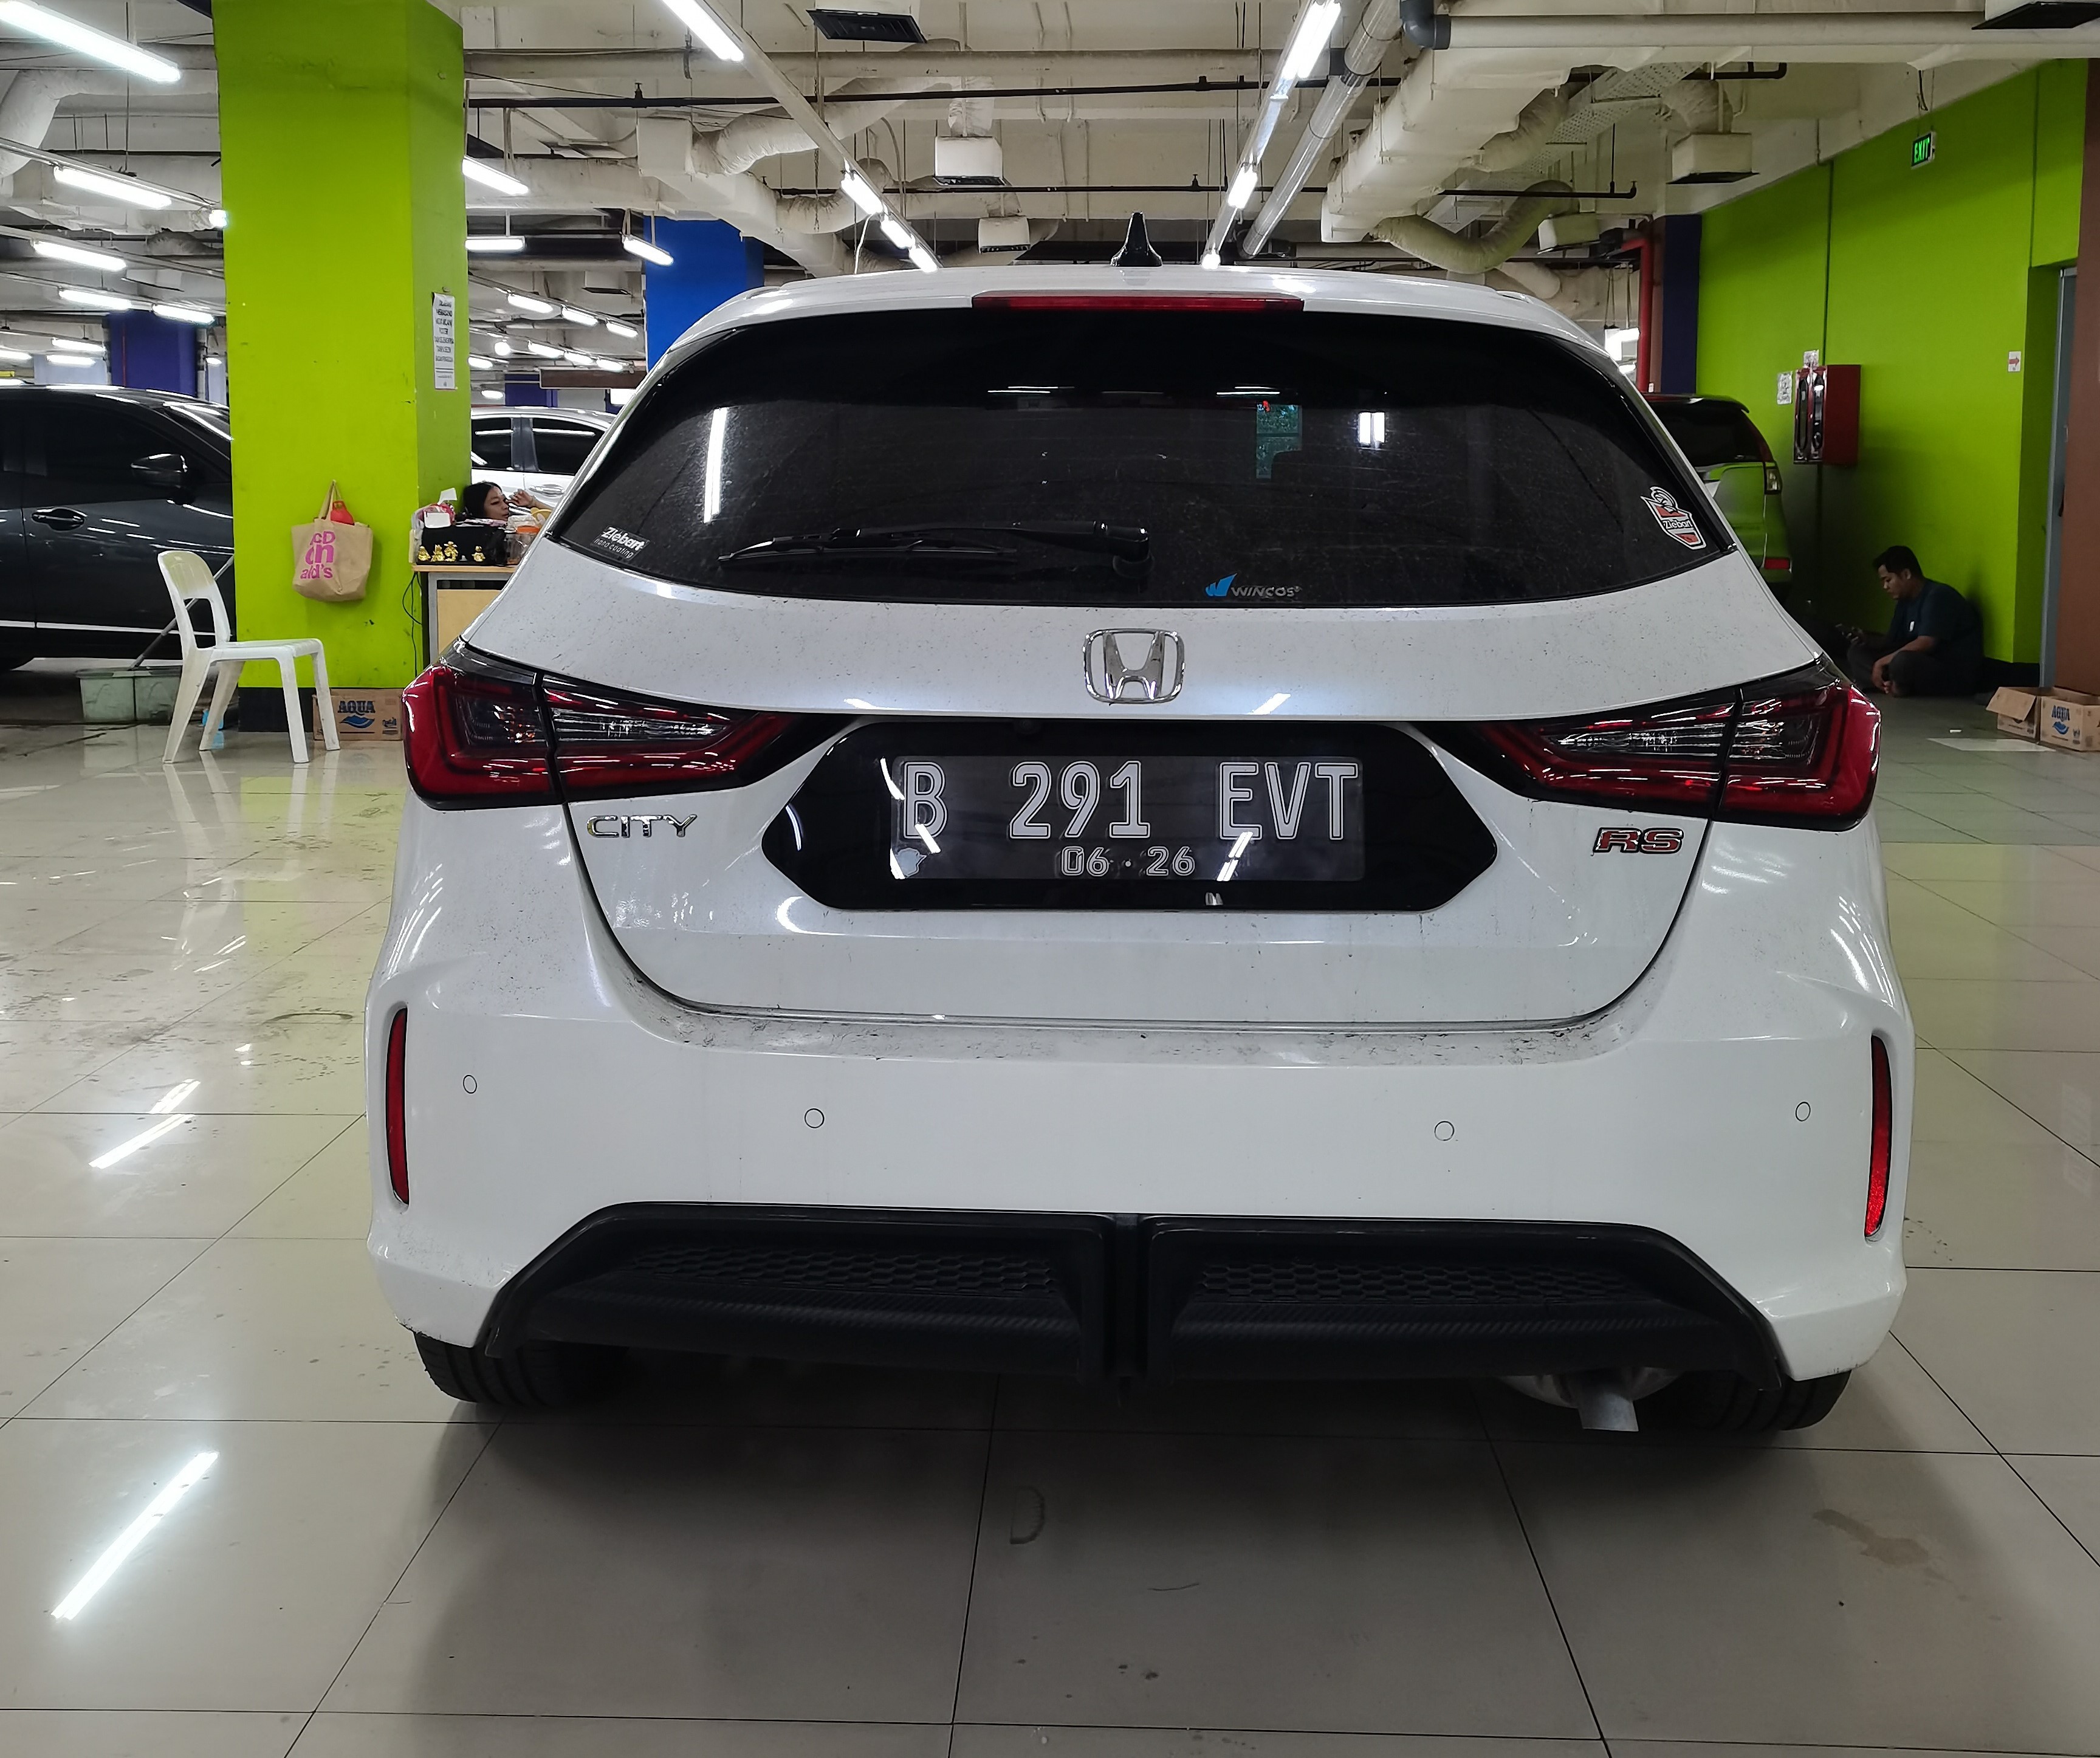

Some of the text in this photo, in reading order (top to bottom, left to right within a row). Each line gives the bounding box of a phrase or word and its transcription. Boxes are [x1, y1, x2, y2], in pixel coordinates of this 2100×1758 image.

[1913, 137, 1930, 163] EXIT
[609, 544, 634, 559] coating
[337, 700, 376, 716] AQUA
[2051, 705, 2070, 723] AQUA
[903, 760, 1359, 840] B 291 EVT
[586, 813, 698, 839] CITY
[1592, 826, 1685, 854] RS
